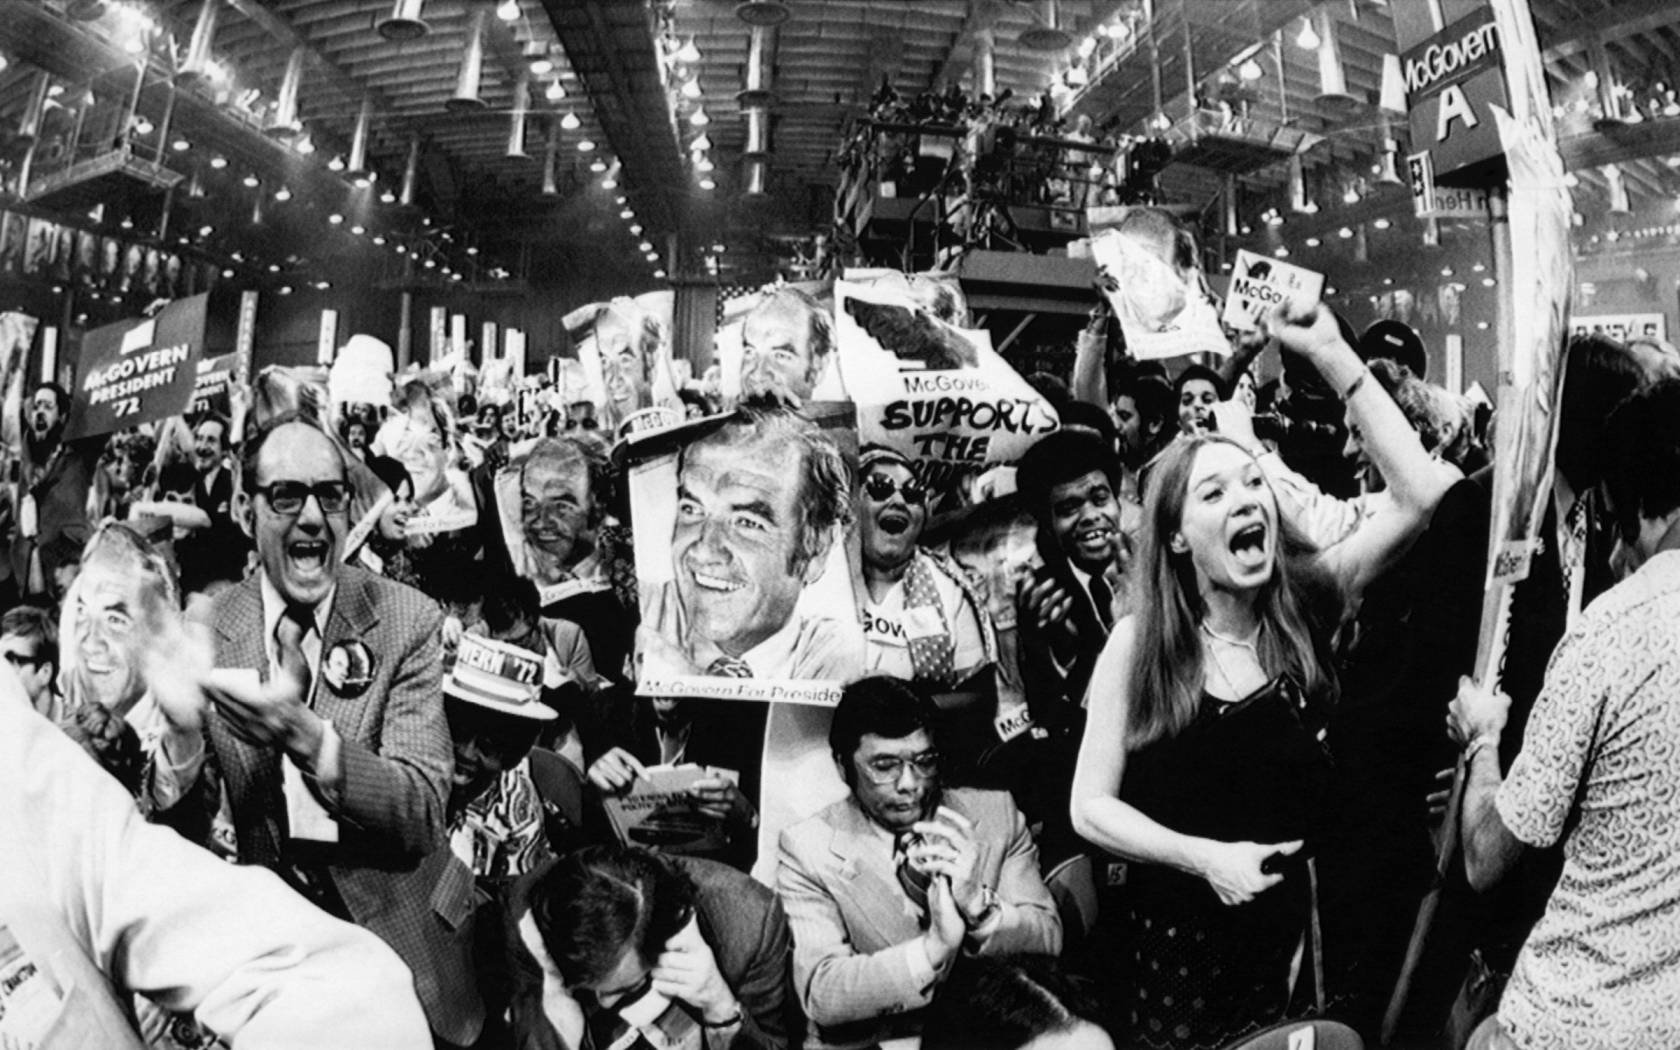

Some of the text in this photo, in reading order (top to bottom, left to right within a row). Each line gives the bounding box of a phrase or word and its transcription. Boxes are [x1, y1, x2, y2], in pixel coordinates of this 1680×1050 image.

[1436, 84, 1478, 142] A
[83, 343, 189, 391] McGOVERN
[90, 366, 176, 406] PRESIDENT
[111, 397, 141, 418] '72
[879, 396, 1061, 434] SUPPORTS
[912, 432, 991, 462] THE
[645, 680, 733, 695] McGovern
[736, 685, 766, 697] For
